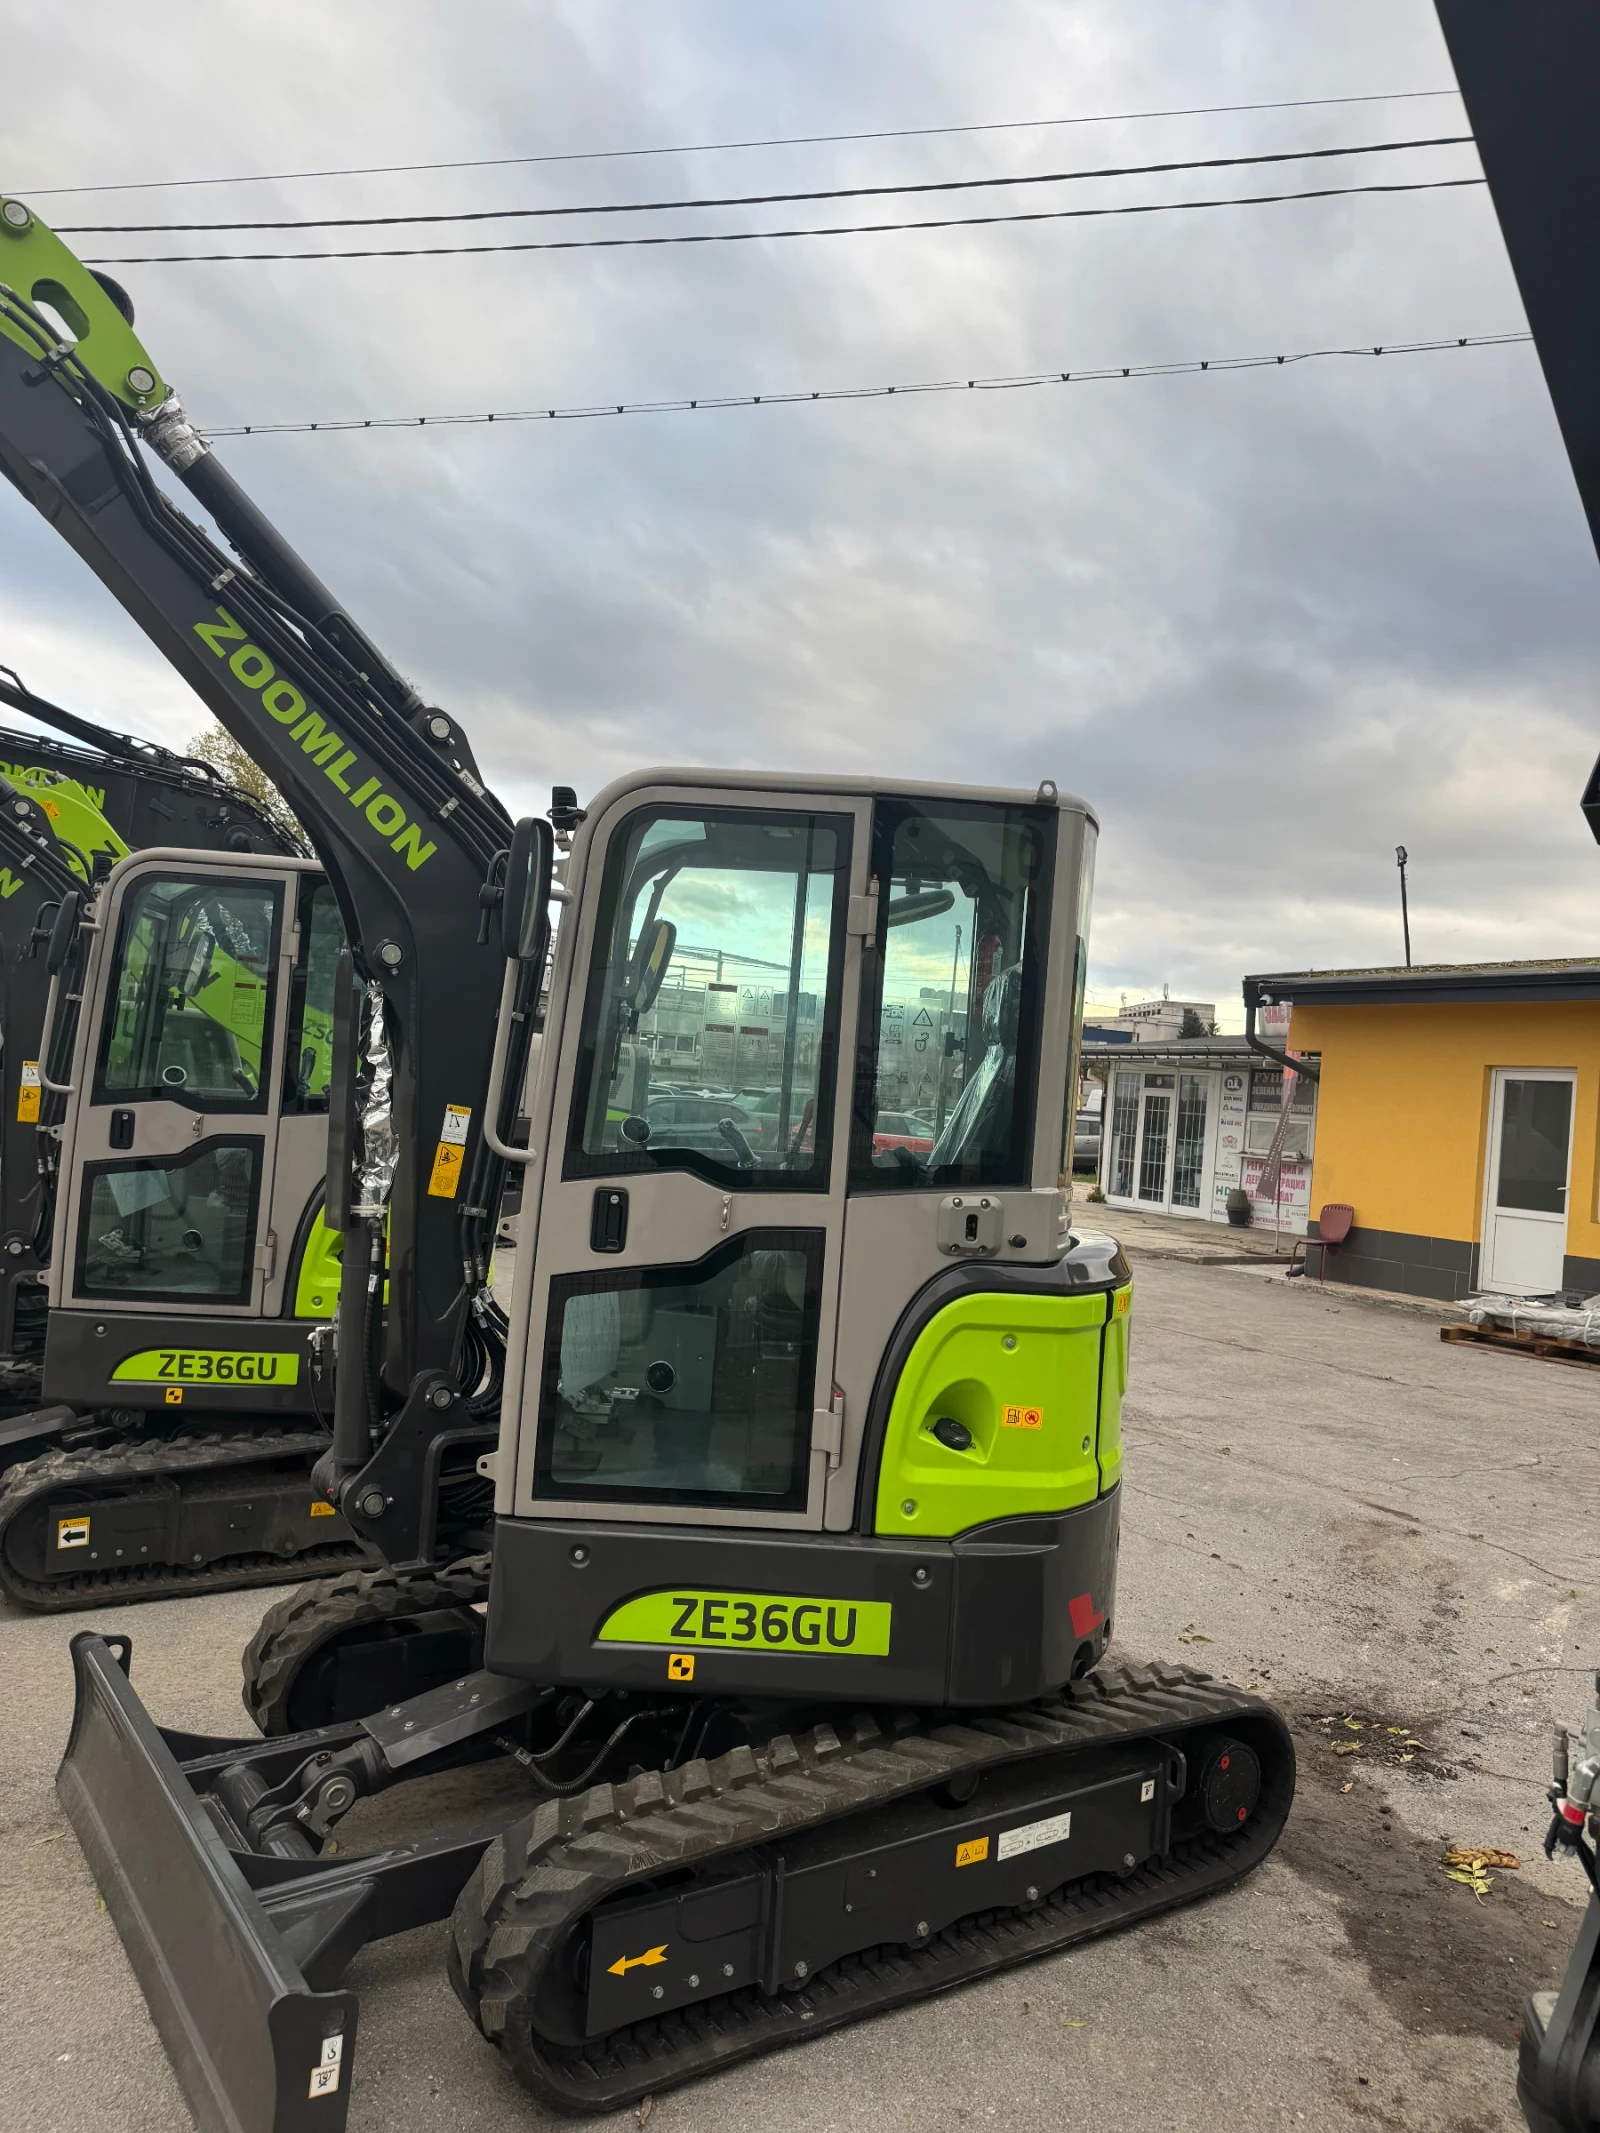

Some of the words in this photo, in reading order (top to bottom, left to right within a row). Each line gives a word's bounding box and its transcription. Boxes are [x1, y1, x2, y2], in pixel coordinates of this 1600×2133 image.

[194, 606, 438, 872] ZOOMLION
[1247, 1161, 1296, 1175] РЕГИЦИЯ
[1216, 1186, 1230, 1196] HD
[1245, 1175, 1306, 1190] ДЕРРАЦИЯ
[158, 1353, 278, 1381] ZE36GU
[670, 1597, 857, 1647] ZE36GU
